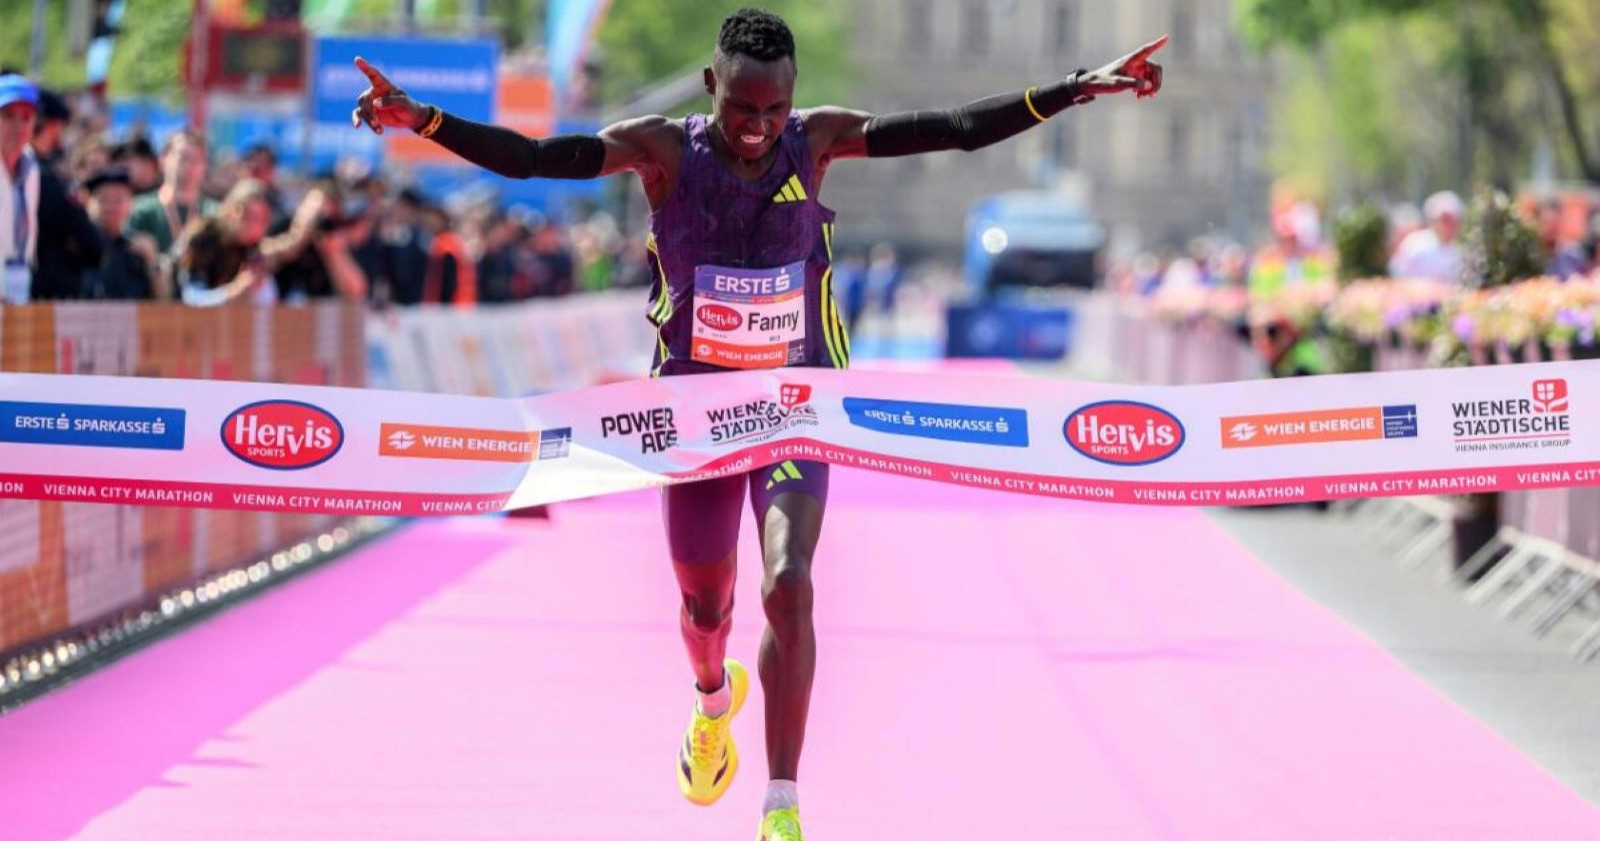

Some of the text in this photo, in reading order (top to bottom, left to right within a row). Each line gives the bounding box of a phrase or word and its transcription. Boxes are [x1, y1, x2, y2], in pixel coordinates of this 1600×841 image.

[715, 275, 773, 294] ERSTE
[747, 310, 799, 332] Fanny
[1452, 399, 1530, 417] WIENER
[15, 415, 150, 434] ERSTE SPARKASSE
[601, 407, 676, 438] POWER
[919, 416, 994, 432] SPARKASSE
[1263, 422, 1305, 436] WIEN
[1309, 417, 1375, 433] ENERGIE
[1453, 415, 1570, 436] STÄDTISCHE
[235, 414, 333, 455] Hervis
[1077, 414, 1174, 453] Hervis
[247, 446, 286, 458] SPORTS
[421, 435, 464, 449] WIEN
[467, 438, 533, 453] ENERGIE
[1091, 445, 1129, 456] SPORTS
[1455, 439, 1571, 452] VIENNA INSURANCE GROUP
[770, 444, 933, 476] VIENNA CITY MARATHON
[951, 471, 1114, 498] VIENNA CITY MARATHON
[1325, 475, 1497, 494] VIENNA CITY MARATHON
[1517, 471, 1570, 484] VIENNA
[43, 483, 212, 502] VIENNA CITY MARATHON
[1134, 485, 1304, 500] VIENNA CITY MARATHON
[233, 493, 401, 512] VIENNA CITY MARATHON
[421, 501, 472, 511] VIENNA
